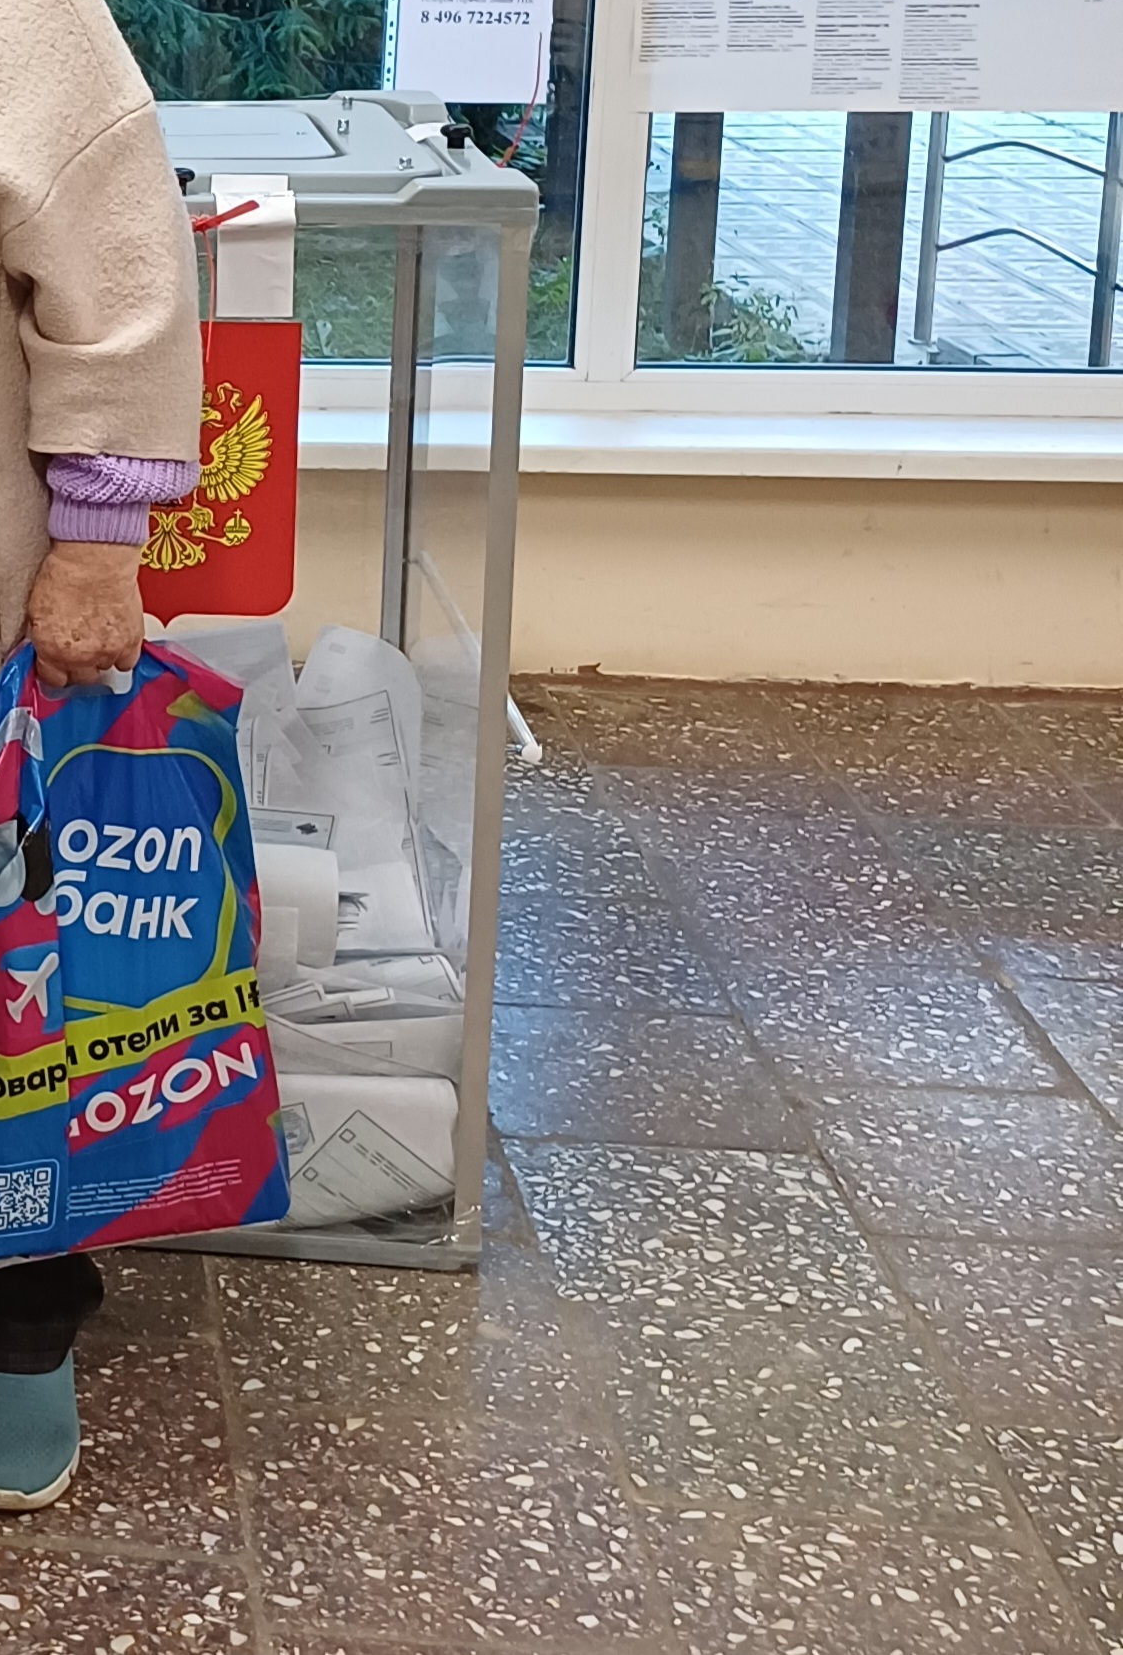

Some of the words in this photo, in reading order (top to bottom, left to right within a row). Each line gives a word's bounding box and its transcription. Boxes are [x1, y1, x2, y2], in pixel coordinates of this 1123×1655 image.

[421, 10, 430, 24] 8
[434, 10, 462, 24] 496
[467, 11, 530, 25] 7224572
[58, 818, 203, 874] ozon
[54, 870, 199, 939] банк
[87, 1015, 180, 1061] отели
[187, 999, 229, 1026] за
[85, 1041, 258, 1132] OZON
